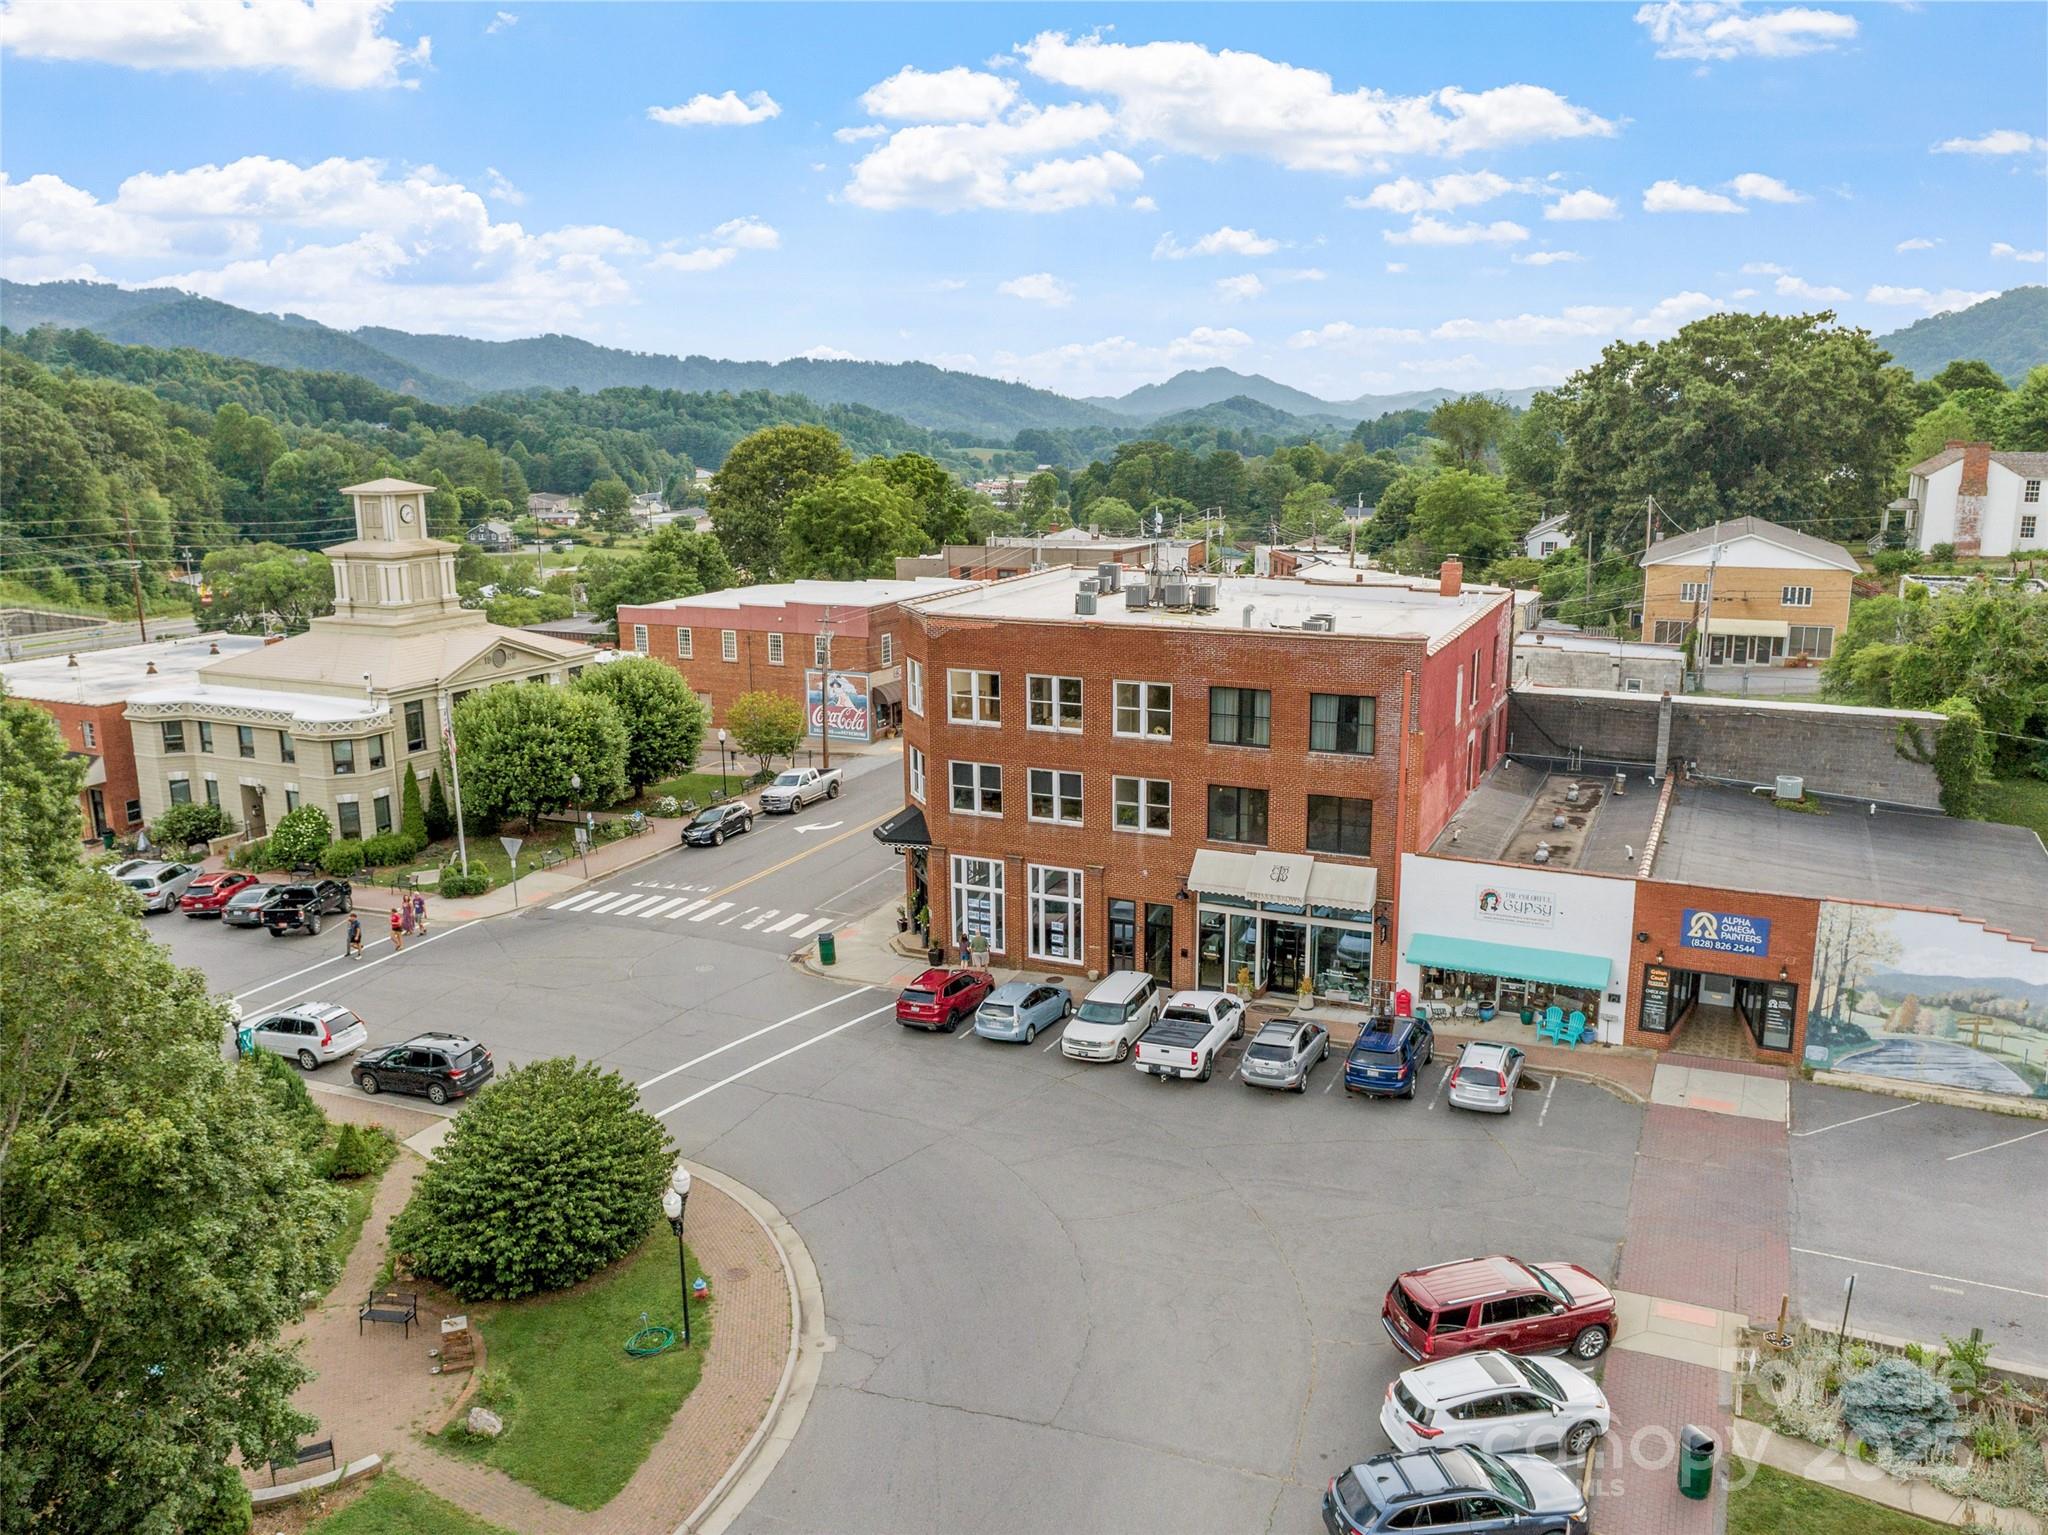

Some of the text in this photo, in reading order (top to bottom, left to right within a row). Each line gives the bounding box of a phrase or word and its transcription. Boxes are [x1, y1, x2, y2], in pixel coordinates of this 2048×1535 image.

[1722, 916, 1751, 927] ALPHA
[1721, 924, 1756, 935] OMEGA
[1720, 932, 1762, 944] PAINTERS
[1691, 938, 1755, 953] (828) 826 2544
